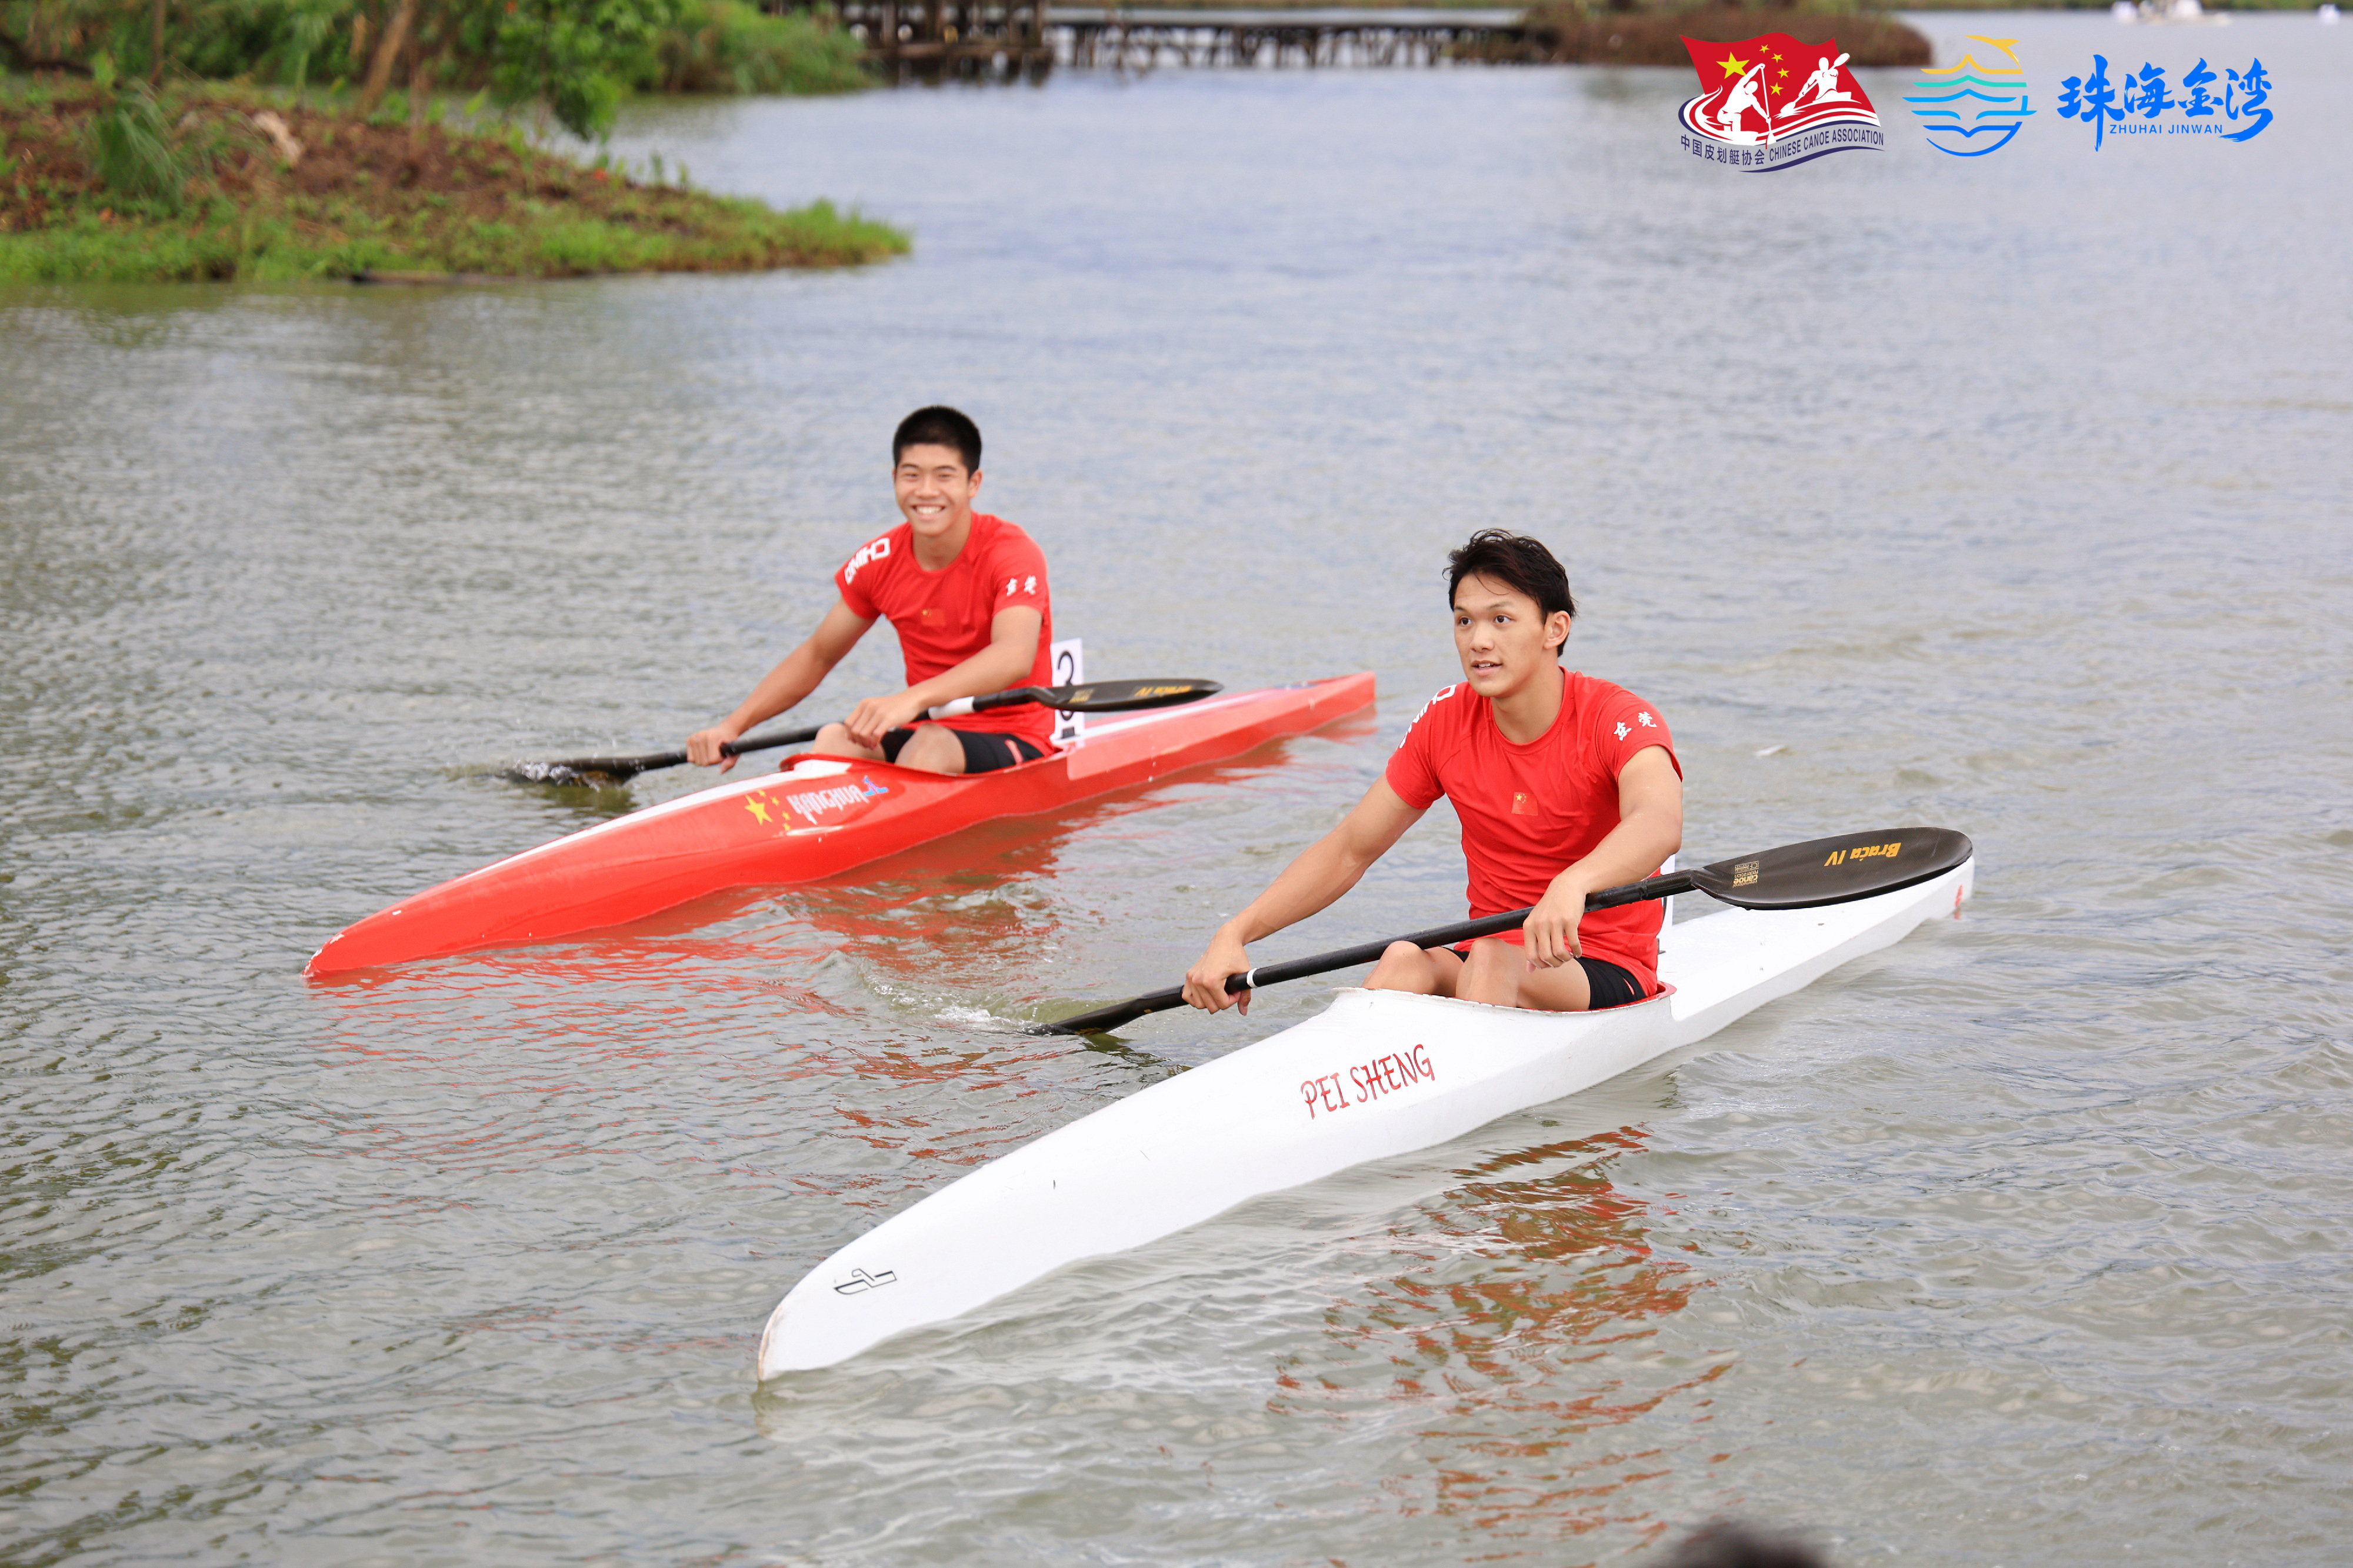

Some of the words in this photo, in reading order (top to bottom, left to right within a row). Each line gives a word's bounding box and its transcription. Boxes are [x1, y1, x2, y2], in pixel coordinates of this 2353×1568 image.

[1824, 850, 1847, 866] IV
[1733, 875, 1758, 884] canoe
[1301, 1072, 1350, 1120] PEI
[1350, 1044, 1435, 1103] SHENG
